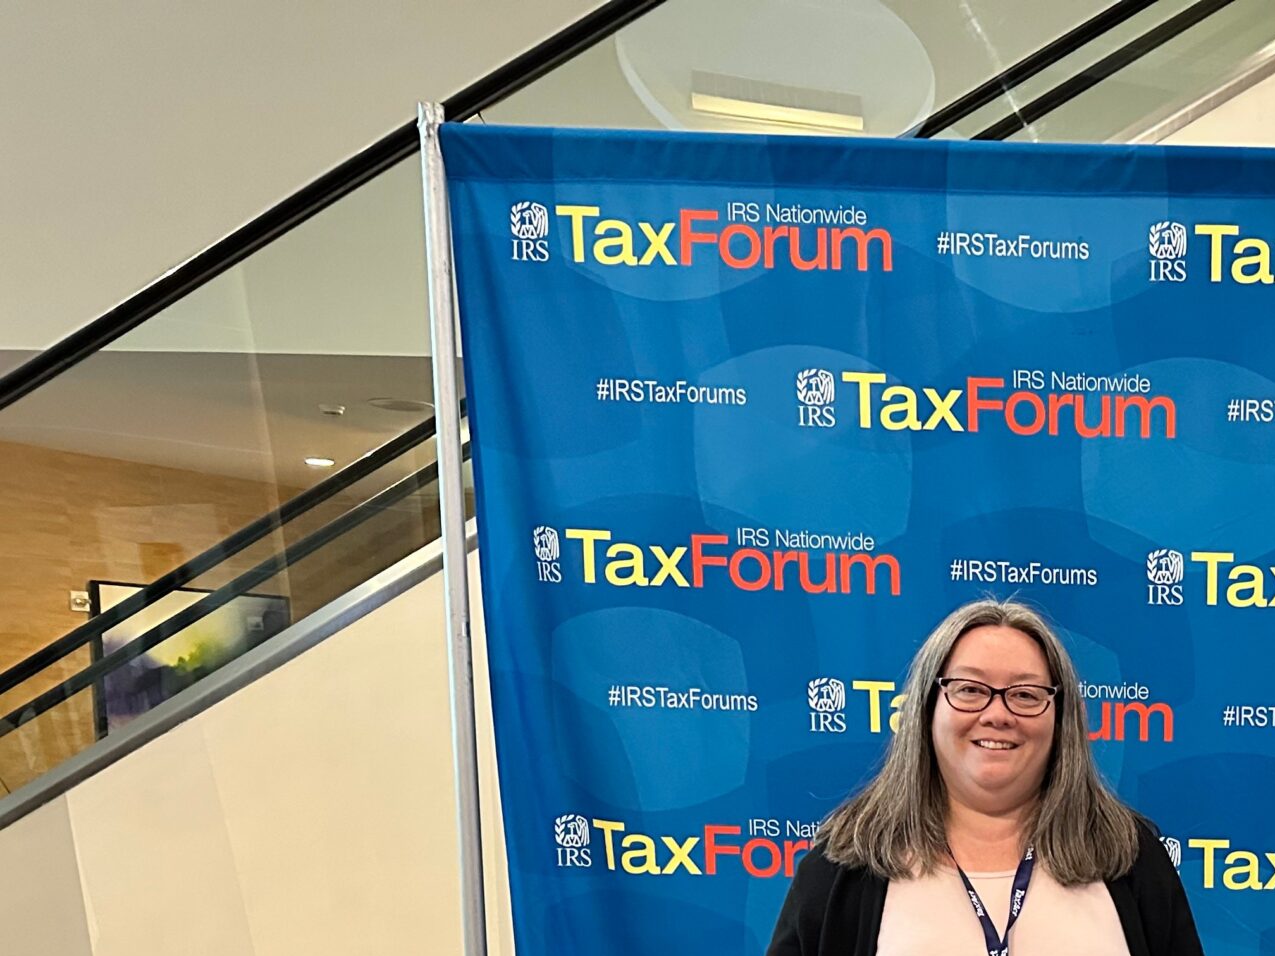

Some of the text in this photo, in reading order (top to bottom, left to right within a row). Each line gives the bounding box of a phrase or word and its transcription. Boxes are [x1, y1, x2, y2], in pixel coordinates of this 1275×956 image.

[727, 202, 867, 226] IRS Nationwide
[512, 239, 550, 262] IRS
[556, 205, 893, 272] TaxForum
[937, 231, 1090, 260] #IRSTaxForums
[1150, 257, 1187, 282] IRS
[596, 378, 747, 405] #IRSTaxForums
[1013, 369, 1151, 393] IRS Nationwide
[798, 403, 836, 428] IRS
[842, 372, 1176, 439] TaxForum
[737, 527, 875, 551] IRS Nationwide
[536, 558, 562, 583] IRS
[566, 529, 901, 596] TaxForum
[950, 559, 1098, 586] #IRSTaxForums
[1148, 582, 1184, 606] IRS
[608, 685, 758, 711] #IRSTaxForums
[810, 709, 847, 733] IRS
[749, 818, 780, 837] IRS
[557, 847, 592, 867] IRS
[593, 819, 816, 878] TaxFor
